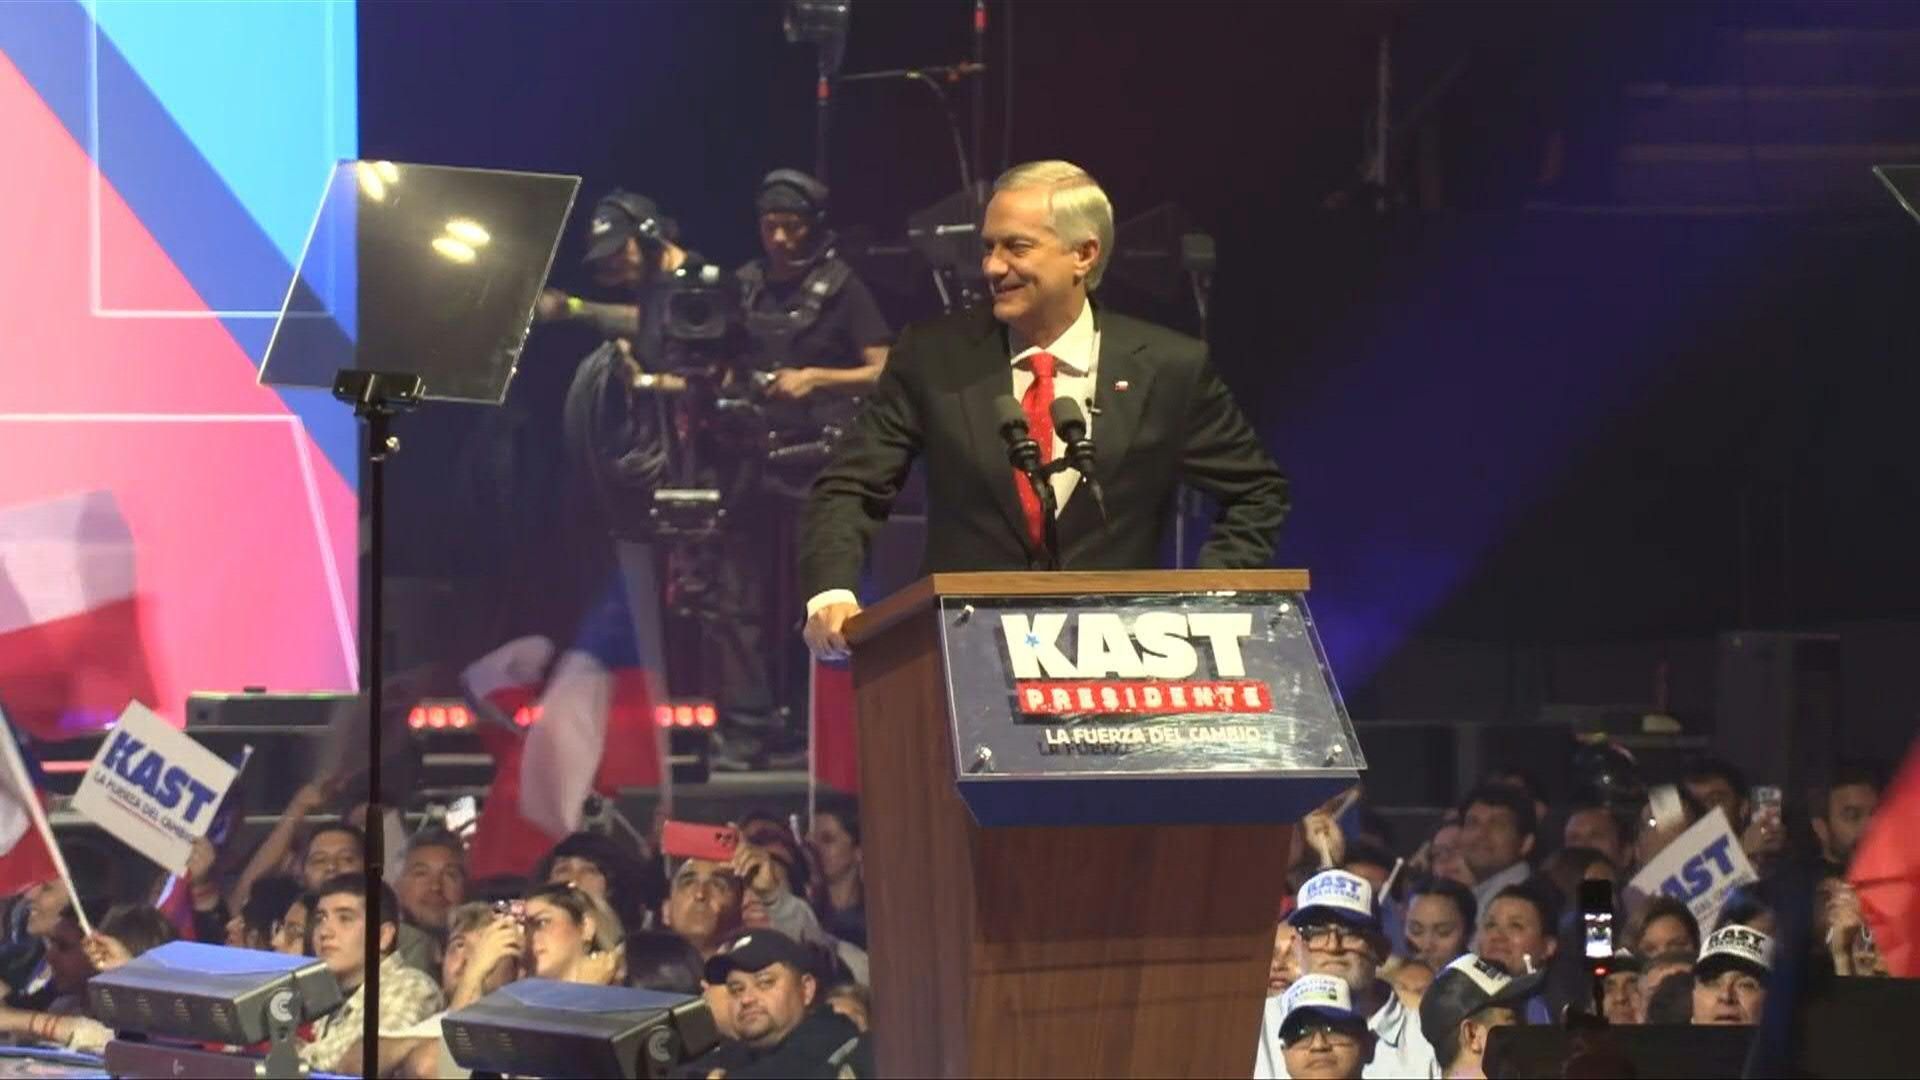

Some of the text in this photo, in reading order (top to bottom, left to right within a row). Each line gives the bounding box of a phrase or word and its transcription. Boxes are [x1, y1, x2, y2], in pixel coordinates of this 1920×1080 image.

[1001, 612, 1253, 678] KAST
[1025, 687, 1262, 710] PRESIDENTE
[1046, 726, 1260, 745] LA FUERZA DEL CAMBIO
[102, 731, 217, 823] KAST
[1659, 833, 1735, 903] AST
